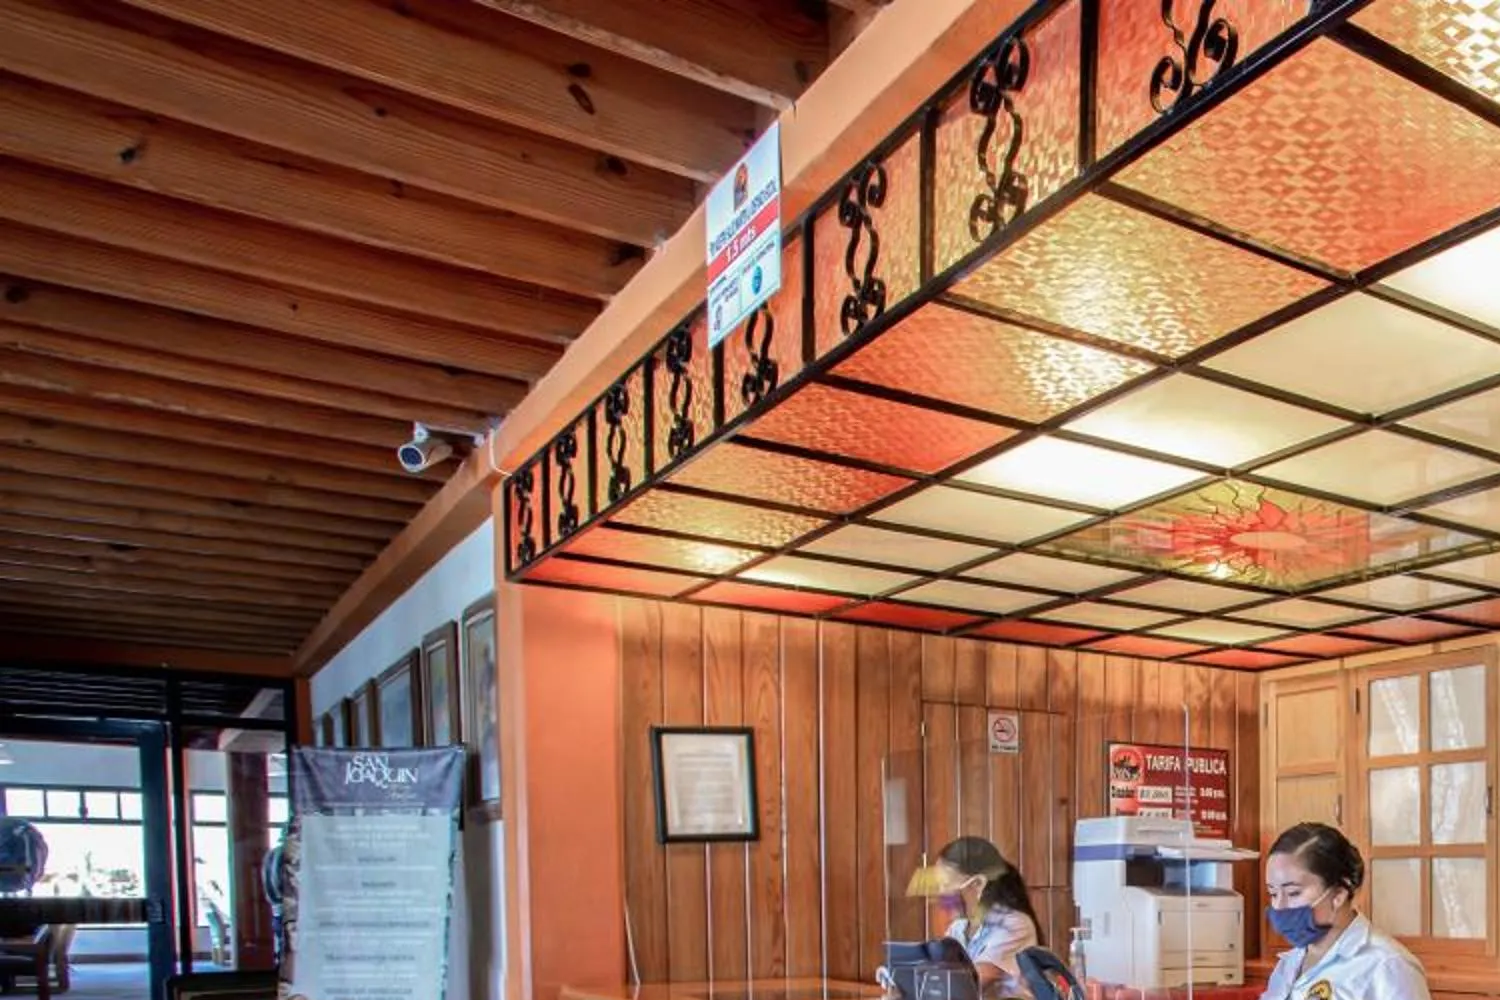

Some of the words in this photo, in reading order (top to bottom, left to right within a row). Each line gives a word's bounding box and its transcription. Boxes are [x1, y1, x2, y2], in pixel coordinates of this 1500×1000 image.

[354, 753, 389, 772] SAN
[1146, 754, 1181, 771] TARIFA
[1185, 757, 1228, 775] PUBLICA
[345, 762, 419, 789] JOAQUIN
